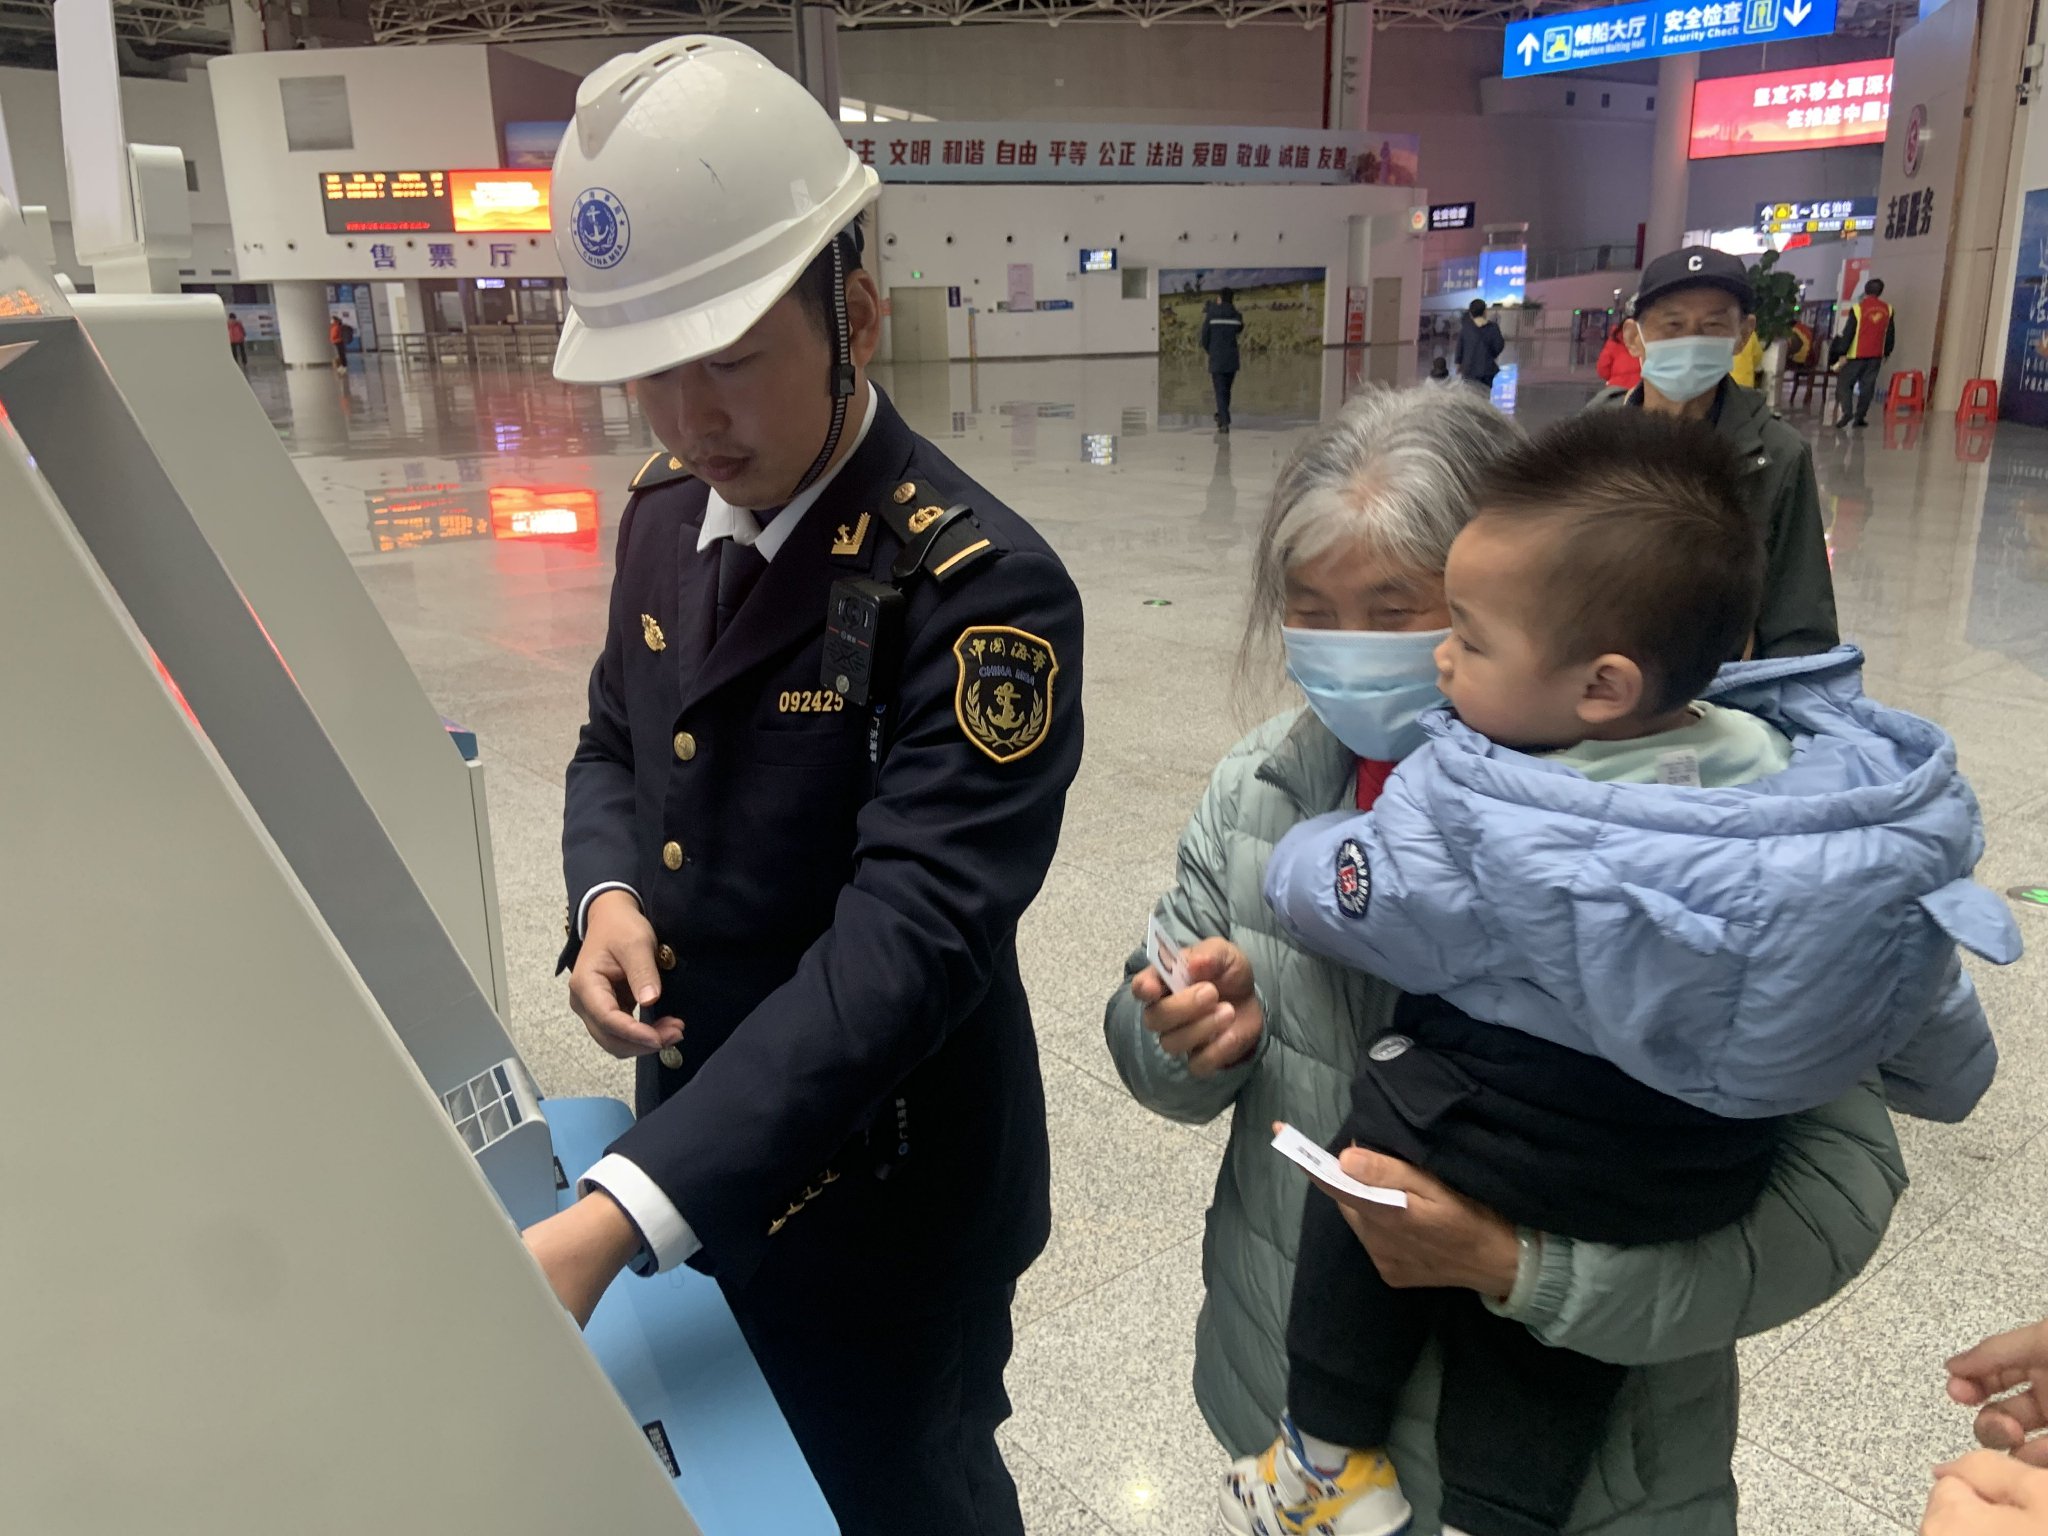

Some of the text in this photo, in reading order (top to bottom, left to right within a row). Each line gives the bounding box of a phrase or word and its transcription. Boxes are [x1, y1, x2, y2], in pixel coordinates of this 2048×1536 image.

[1664, 1, 1743, 32] 安全检查
[1575, 15, 1647, 46] 候船大厅
[1662, 25, 1739, 45] Security Check
[1753, 73, 1893, 107] 坚定不移全面深
[1786, 101, 1889, 128] 在推进中国
[843, 138, 1348, 170] 主 文明 和谐 自由 平等 公正 法治 爱国 敬业 诚信 友善
[370, 243, 517, 269] 售票厅
[583, 244, 623, 265] CHINA MSA
[1688, 255, 1703, 271] C
[779, 690, 844, 712] 092425
